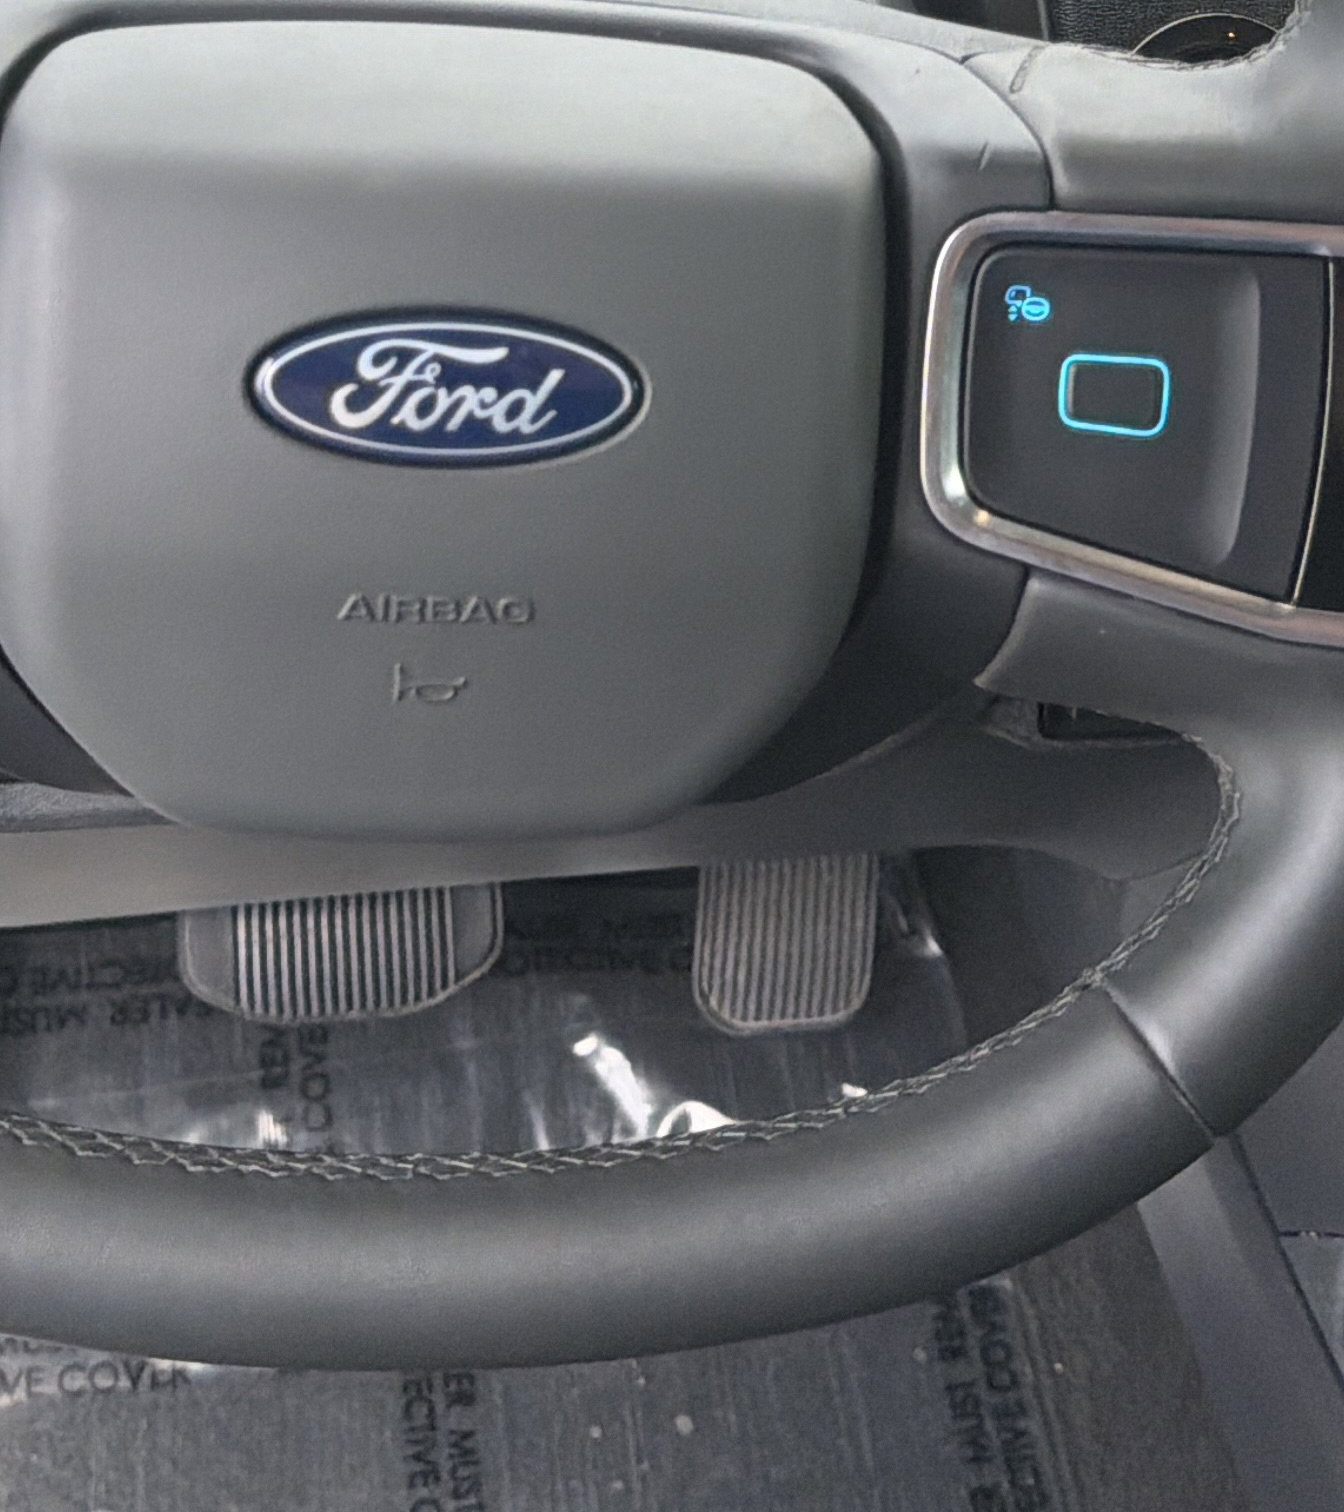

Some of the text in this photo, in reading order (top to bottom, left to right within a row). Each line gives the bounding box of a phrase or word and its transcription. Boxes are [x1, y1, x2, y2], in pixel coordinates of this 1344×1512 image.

[328, 338, 565, 435] Ford
[336, 592, 536, 625] AIRBAG
[58, 1354, 192, 1399] COVER
